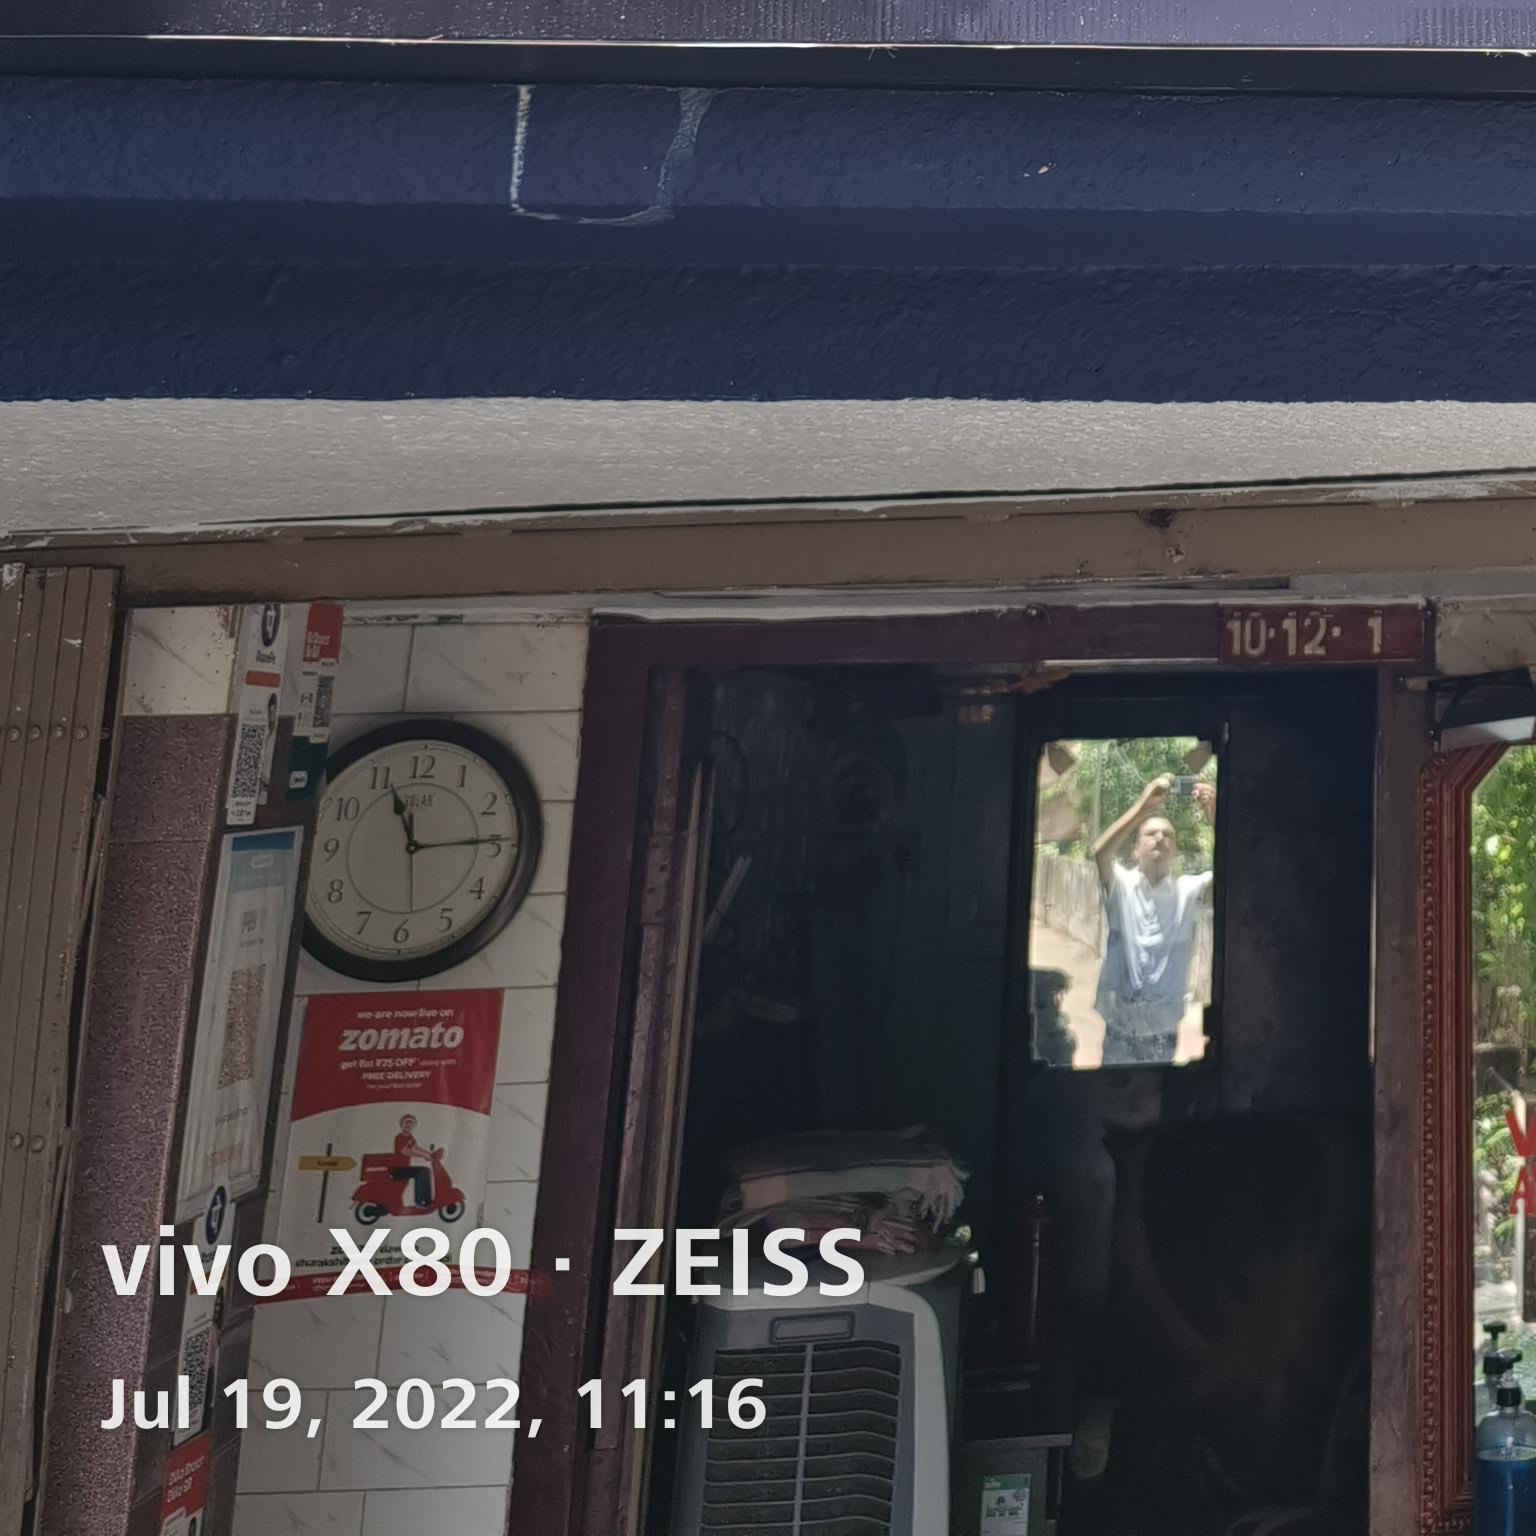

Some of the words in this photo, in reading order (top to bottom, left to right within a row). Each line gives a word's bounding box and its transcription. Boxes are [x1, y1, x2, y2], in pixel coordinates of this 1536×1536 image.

[369, 766, 392, 790] 11
[408, 755, 436, 779] 12
[457, 765, 467, 788] 1
[336, 796, 360, 821] 10
[481, 792, 498, 815] 2
[324, 838, 340, 862] 9
[327, 879, 344, 904] 8
[469, 876, 486, 900] 4
[357, 910, 372, 935] 7
[393, 919, 410, 944] 6
[436, 908, 454, 933] 5
[439, 1009, 455, 1018] on
[338, 1021, 465, 1052] zomato
